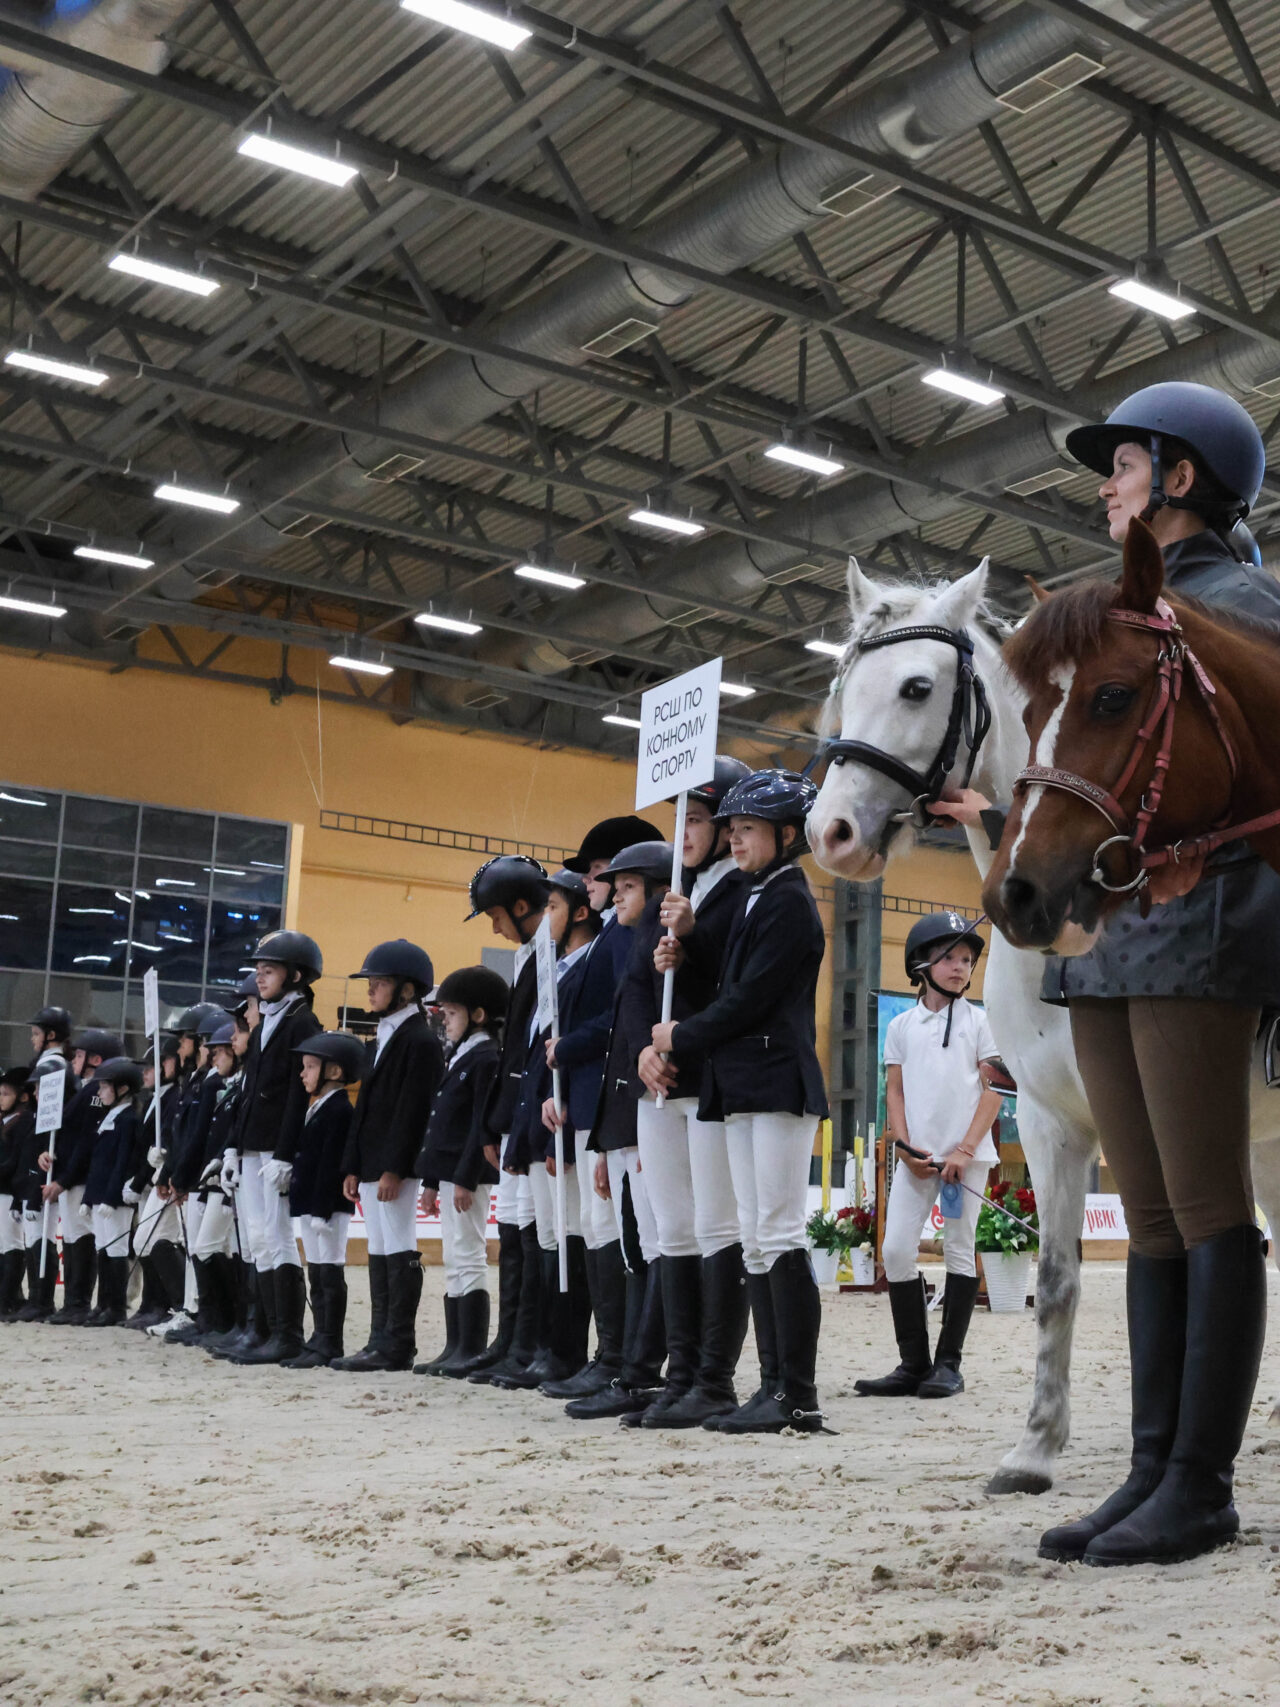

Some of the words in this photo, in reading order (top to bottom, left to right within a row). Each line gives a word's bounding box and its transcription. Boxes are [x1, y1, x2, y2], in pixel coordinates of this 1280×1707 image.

[654, 696, 681, 725] РСШ
[684, 687, 703, 712] ПО
[646, 713, 707, 757] КОННОМУ
[651, 747, 697, 783] СПОРТУ
[1085, 1209, 1119, 1233] рвис
